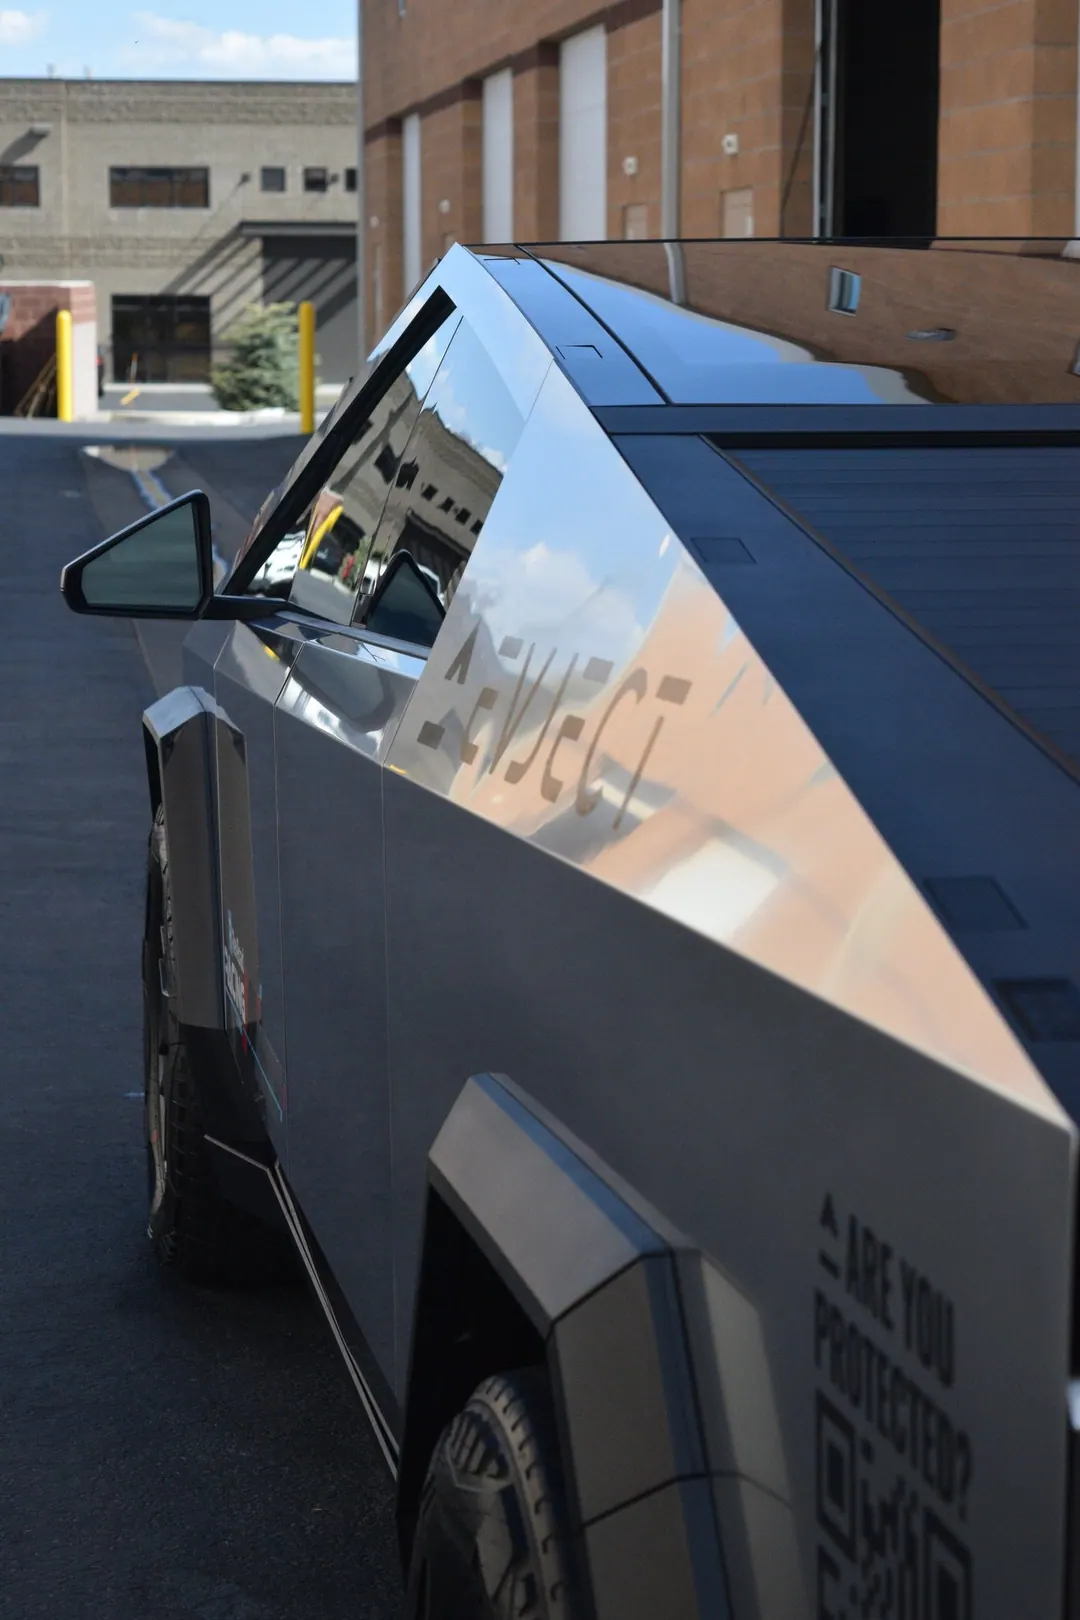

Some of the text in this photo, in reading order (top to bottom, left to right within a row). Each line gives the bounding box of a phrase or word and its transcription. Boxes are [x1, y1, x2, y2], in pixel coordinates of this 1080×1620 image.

[845, 1212, 955, 1388] ARE YOU
[814, 1286, 974, 1521] PROTECTED?
